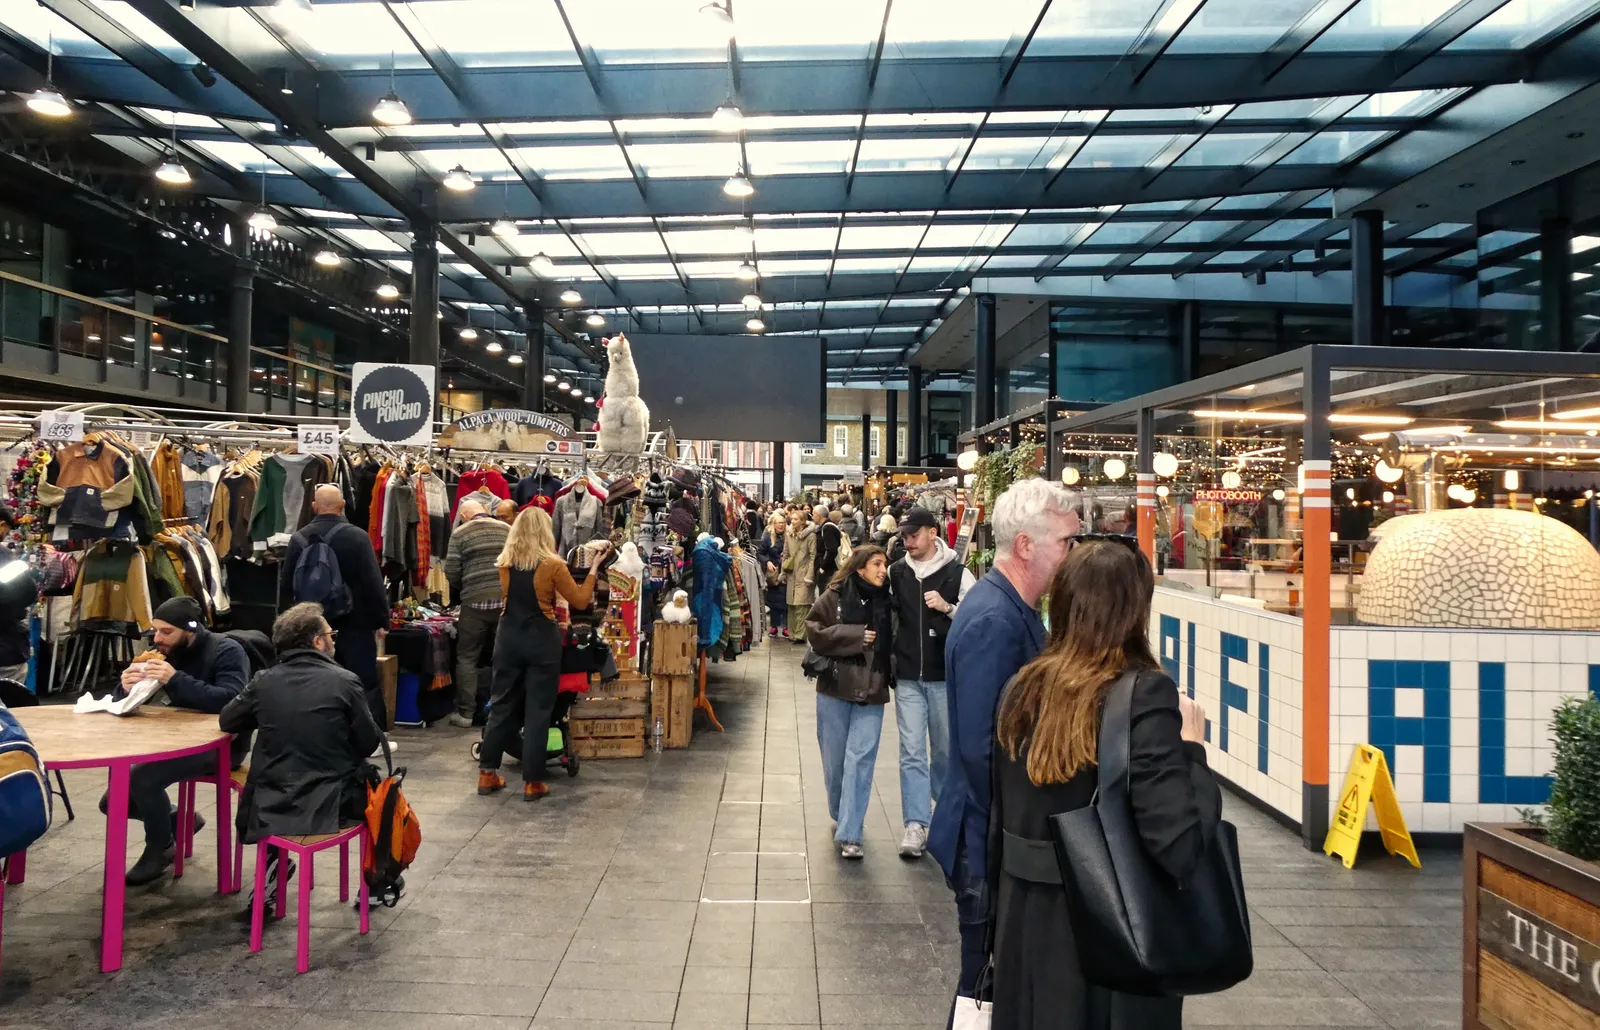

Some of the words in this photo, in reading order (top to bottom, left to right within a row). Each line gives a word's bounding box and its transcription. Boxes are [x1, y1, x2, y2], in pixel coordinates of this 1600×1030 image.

[362, 388, 405, 411] PINCHO
[376, 401, 422, 424] PONCHO
[458, 413, 494, 432] ALPACA
[495, 410, 524, 423] WOOL
[524, 413, 570, 438] JUMPERS
[47, 423, 74, 437] £65
[303, 431, 334, 445] £45
[1195, 489, 1262, 502] PHOTOBOOTH
[1368, 659, 1600, 805] AL
[1506, 909, 1581, 985] THE
